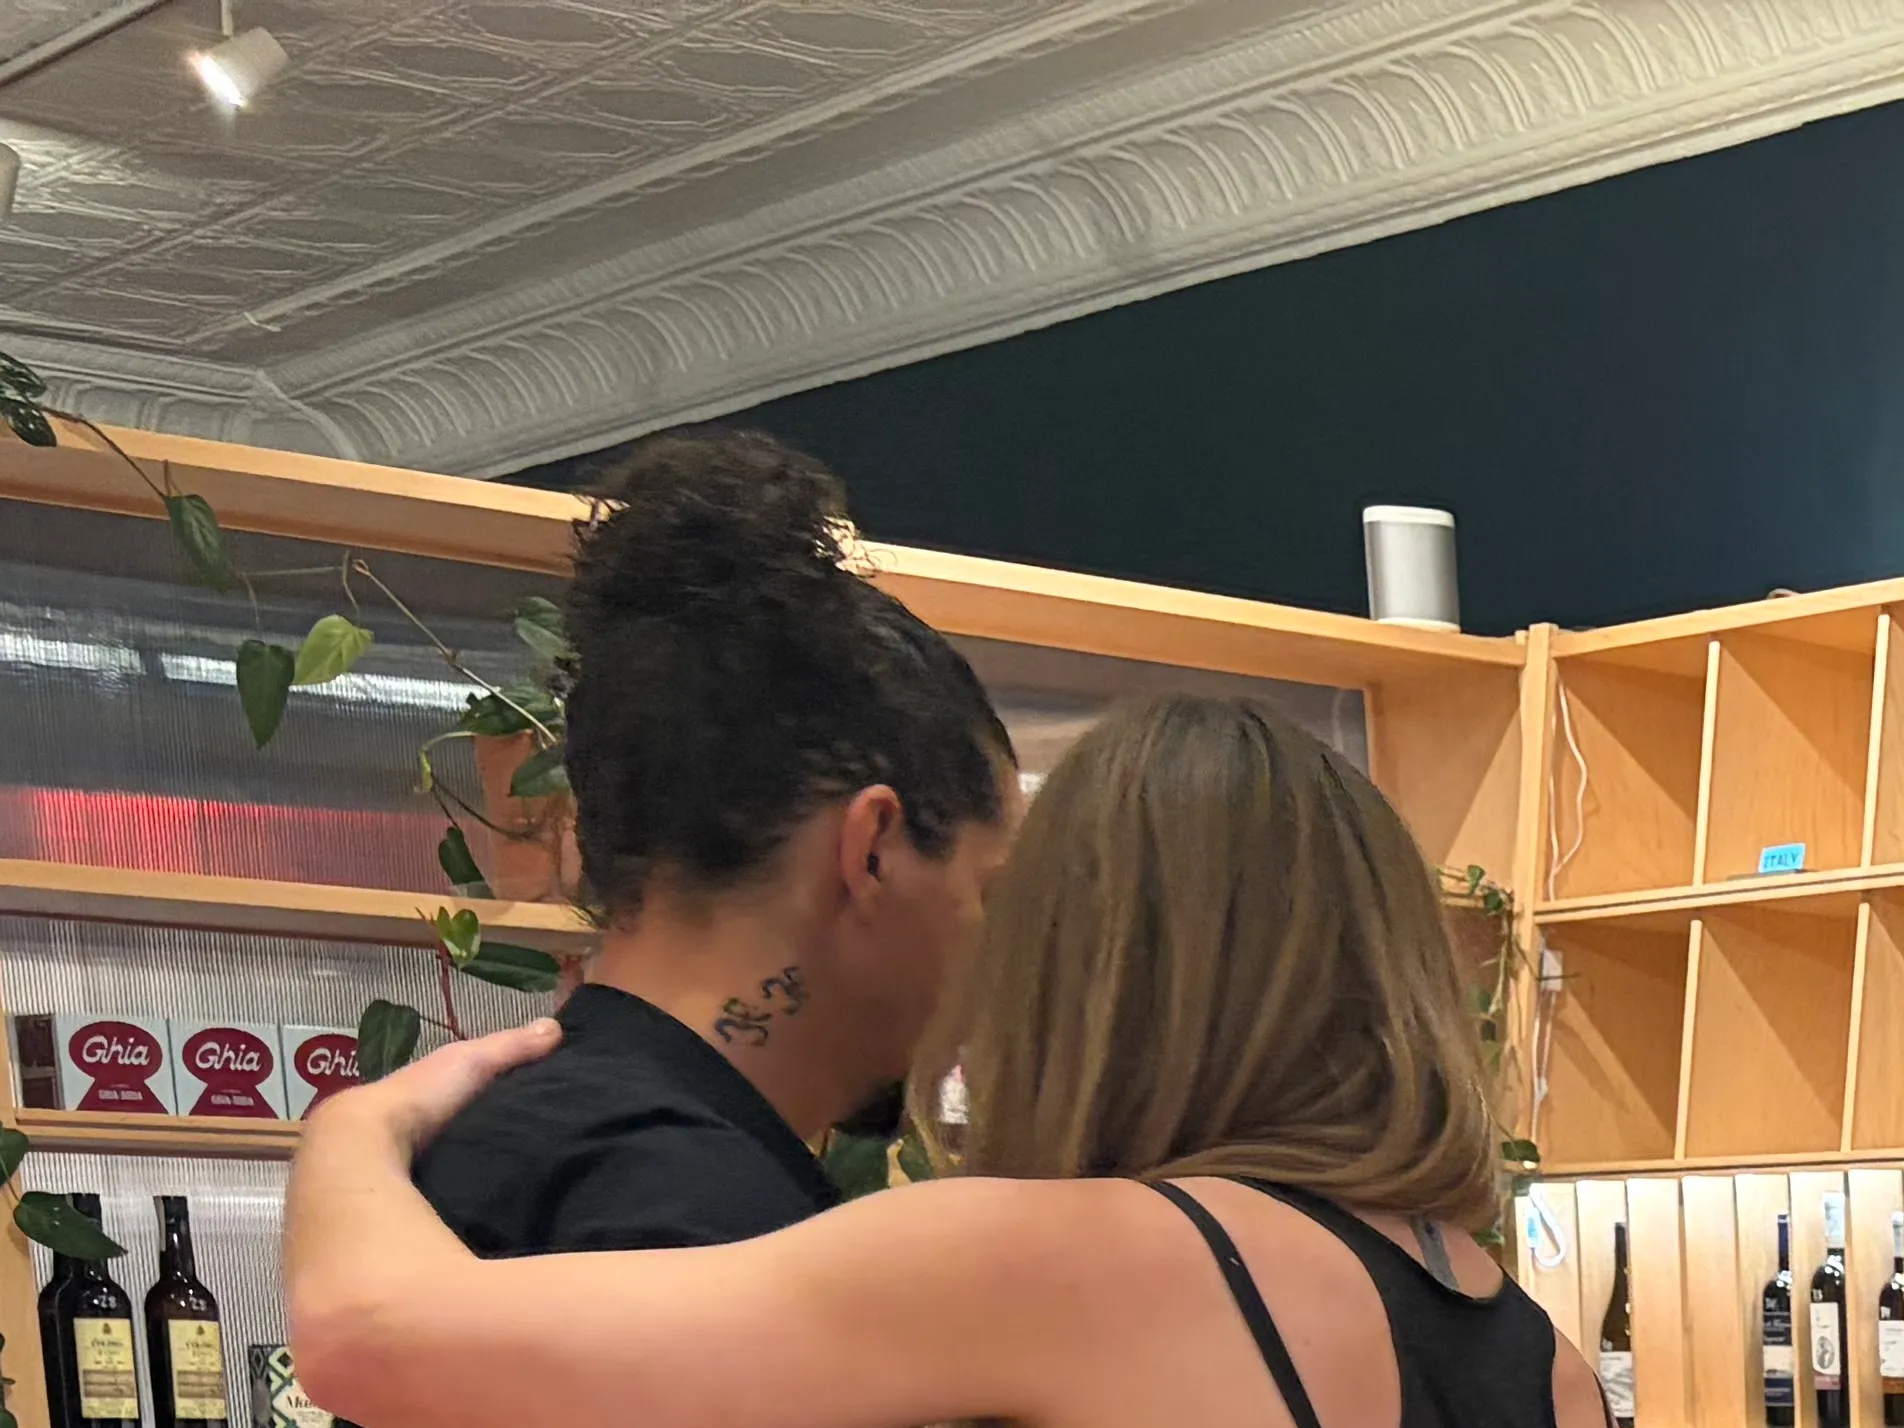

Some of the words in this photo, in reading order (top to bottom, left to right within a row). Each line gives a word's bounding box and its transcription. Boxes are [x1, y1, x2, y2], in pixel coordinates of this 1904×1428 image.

[82, 1035, 150, 1065] Ghia
[195, 1041, 262, 1072] Ghia
[306, 1047, 359, 1076] Ghi
